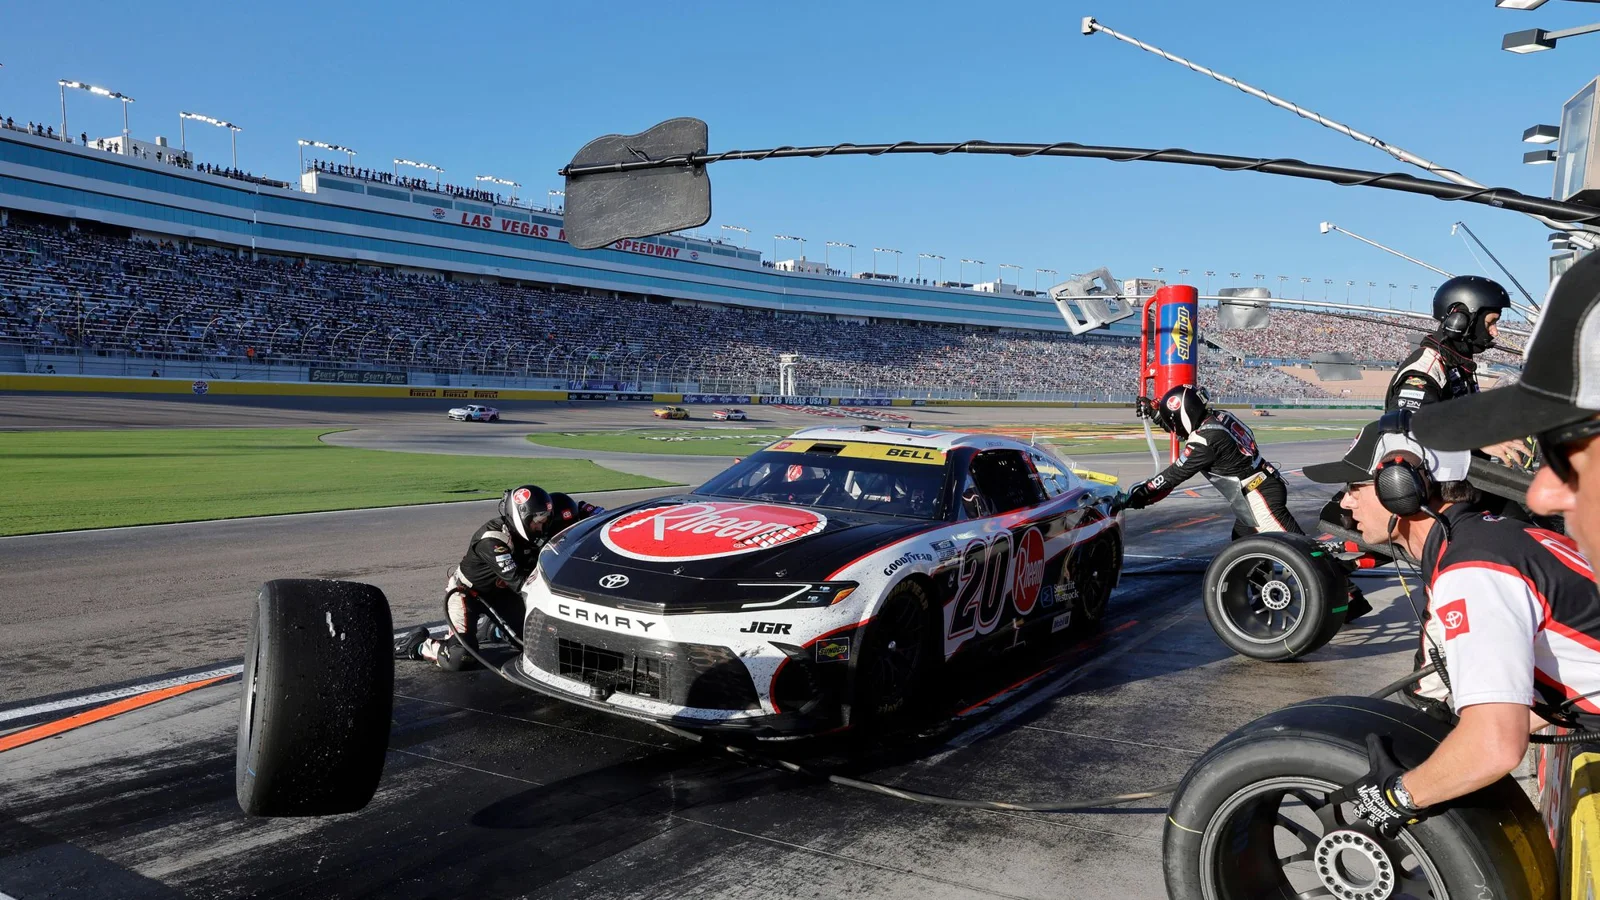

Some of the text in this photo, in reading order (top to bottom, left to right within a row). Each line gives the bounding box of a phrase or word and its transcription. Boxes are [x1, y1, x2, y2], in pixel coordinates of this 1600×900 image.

[461, 212, 491, 229] LAS
[501, 219, 549, 238] VEGAS
[614, 239, 680, 259] SPEEDWAY
[1178, 307, 1189, 359] SUNOCO
[409, 389, 436, 397] PIRELLI
[443, 390, 468, 398] PIRELLI
[473, 390, 498, 398] PIRELLI
[769, 396, 782, 404] LAS
[785, 397, 806, 405] VEGAS
[809, 397, 822, 405] USA
[886, 449, 934, 460] BELL
[654, 502, 792, 542] Rheem
[883, 552, 933, 577] GOODYEAR
[1014, 531, 1043, 600] Rheem
[948, 531, 1012, 640] 20
[558, 604, 656, 632] CAMRY
[740, 621, 793, 635] JGR
[819, 645, 848, 656] SUNOCO
[1357, 784, 1391, 820] Mechanix
[1367, 784, 1401, 818] Mechanix
